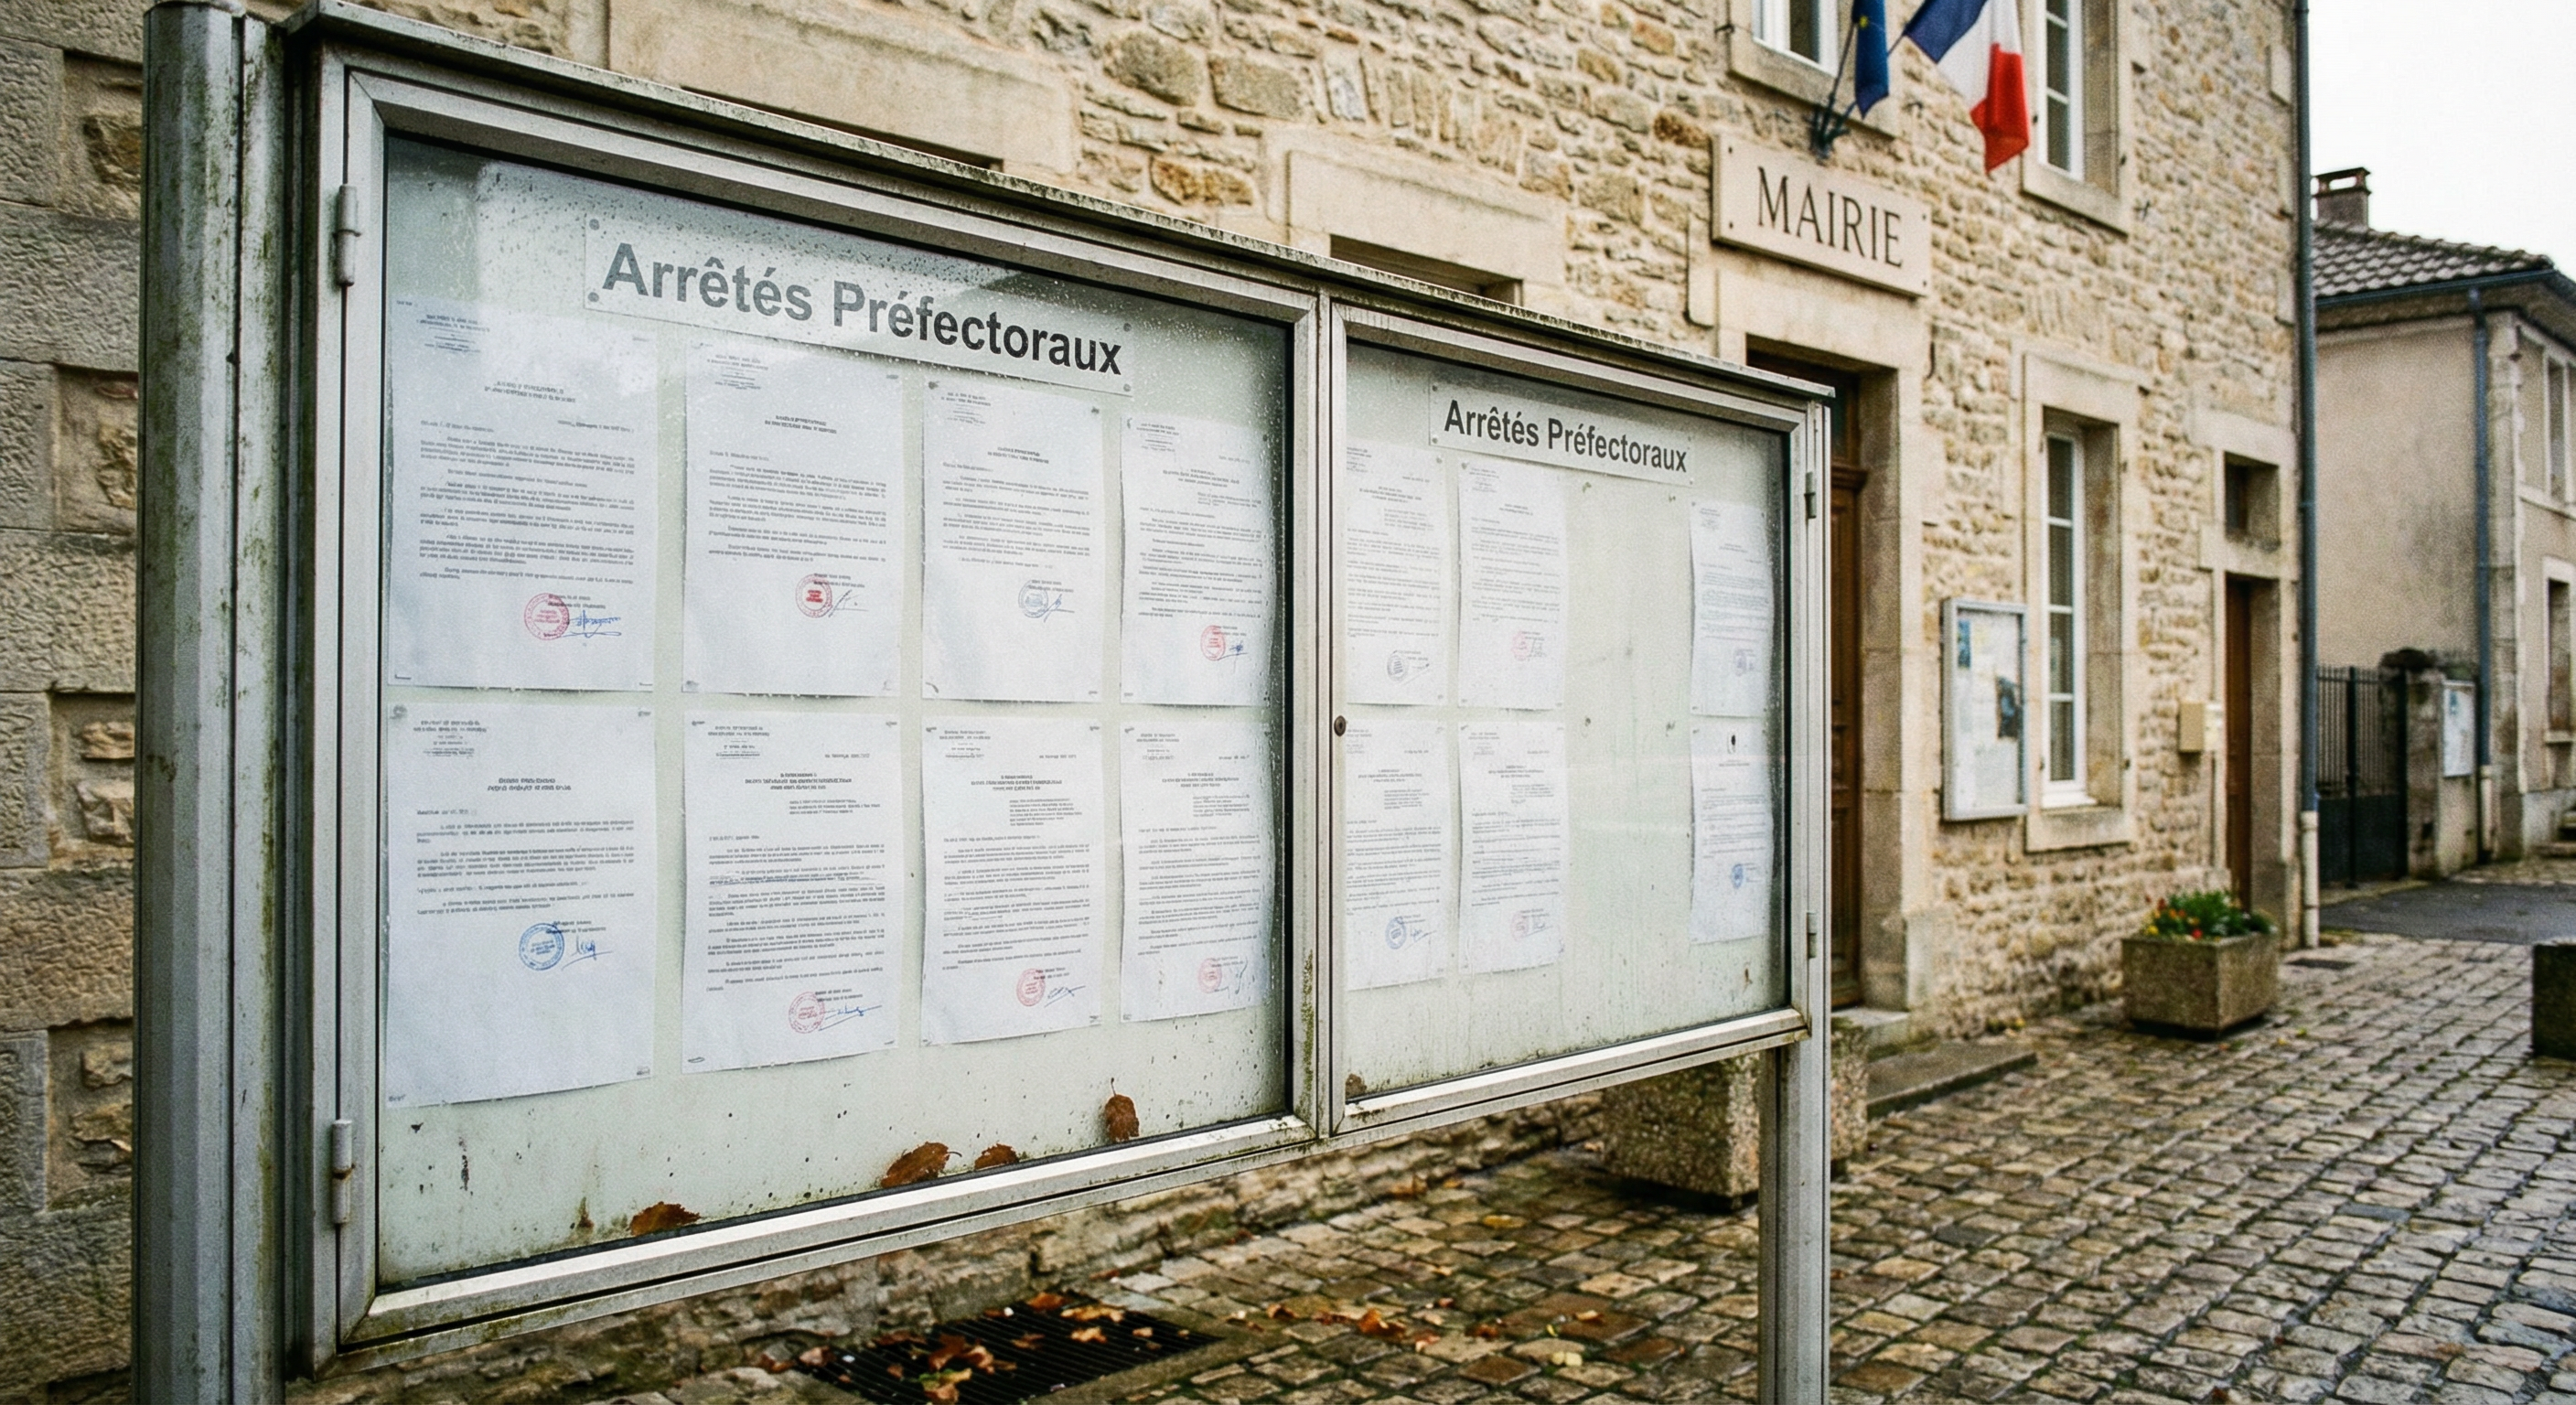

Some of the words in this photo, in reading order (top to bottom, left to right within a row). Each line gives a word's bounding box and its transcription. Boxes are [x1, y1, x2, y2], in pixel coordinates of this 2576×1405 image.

[1757, 166, 1904, 269] MAIRIE
[602, 241, 813, 322] Arrêtés
[833, 280, 1122, 376] Préfectoraux
[1444, 399, 1540, 446] Arrêtés
[1548, 417, 1687, 473] Préfectoraux
